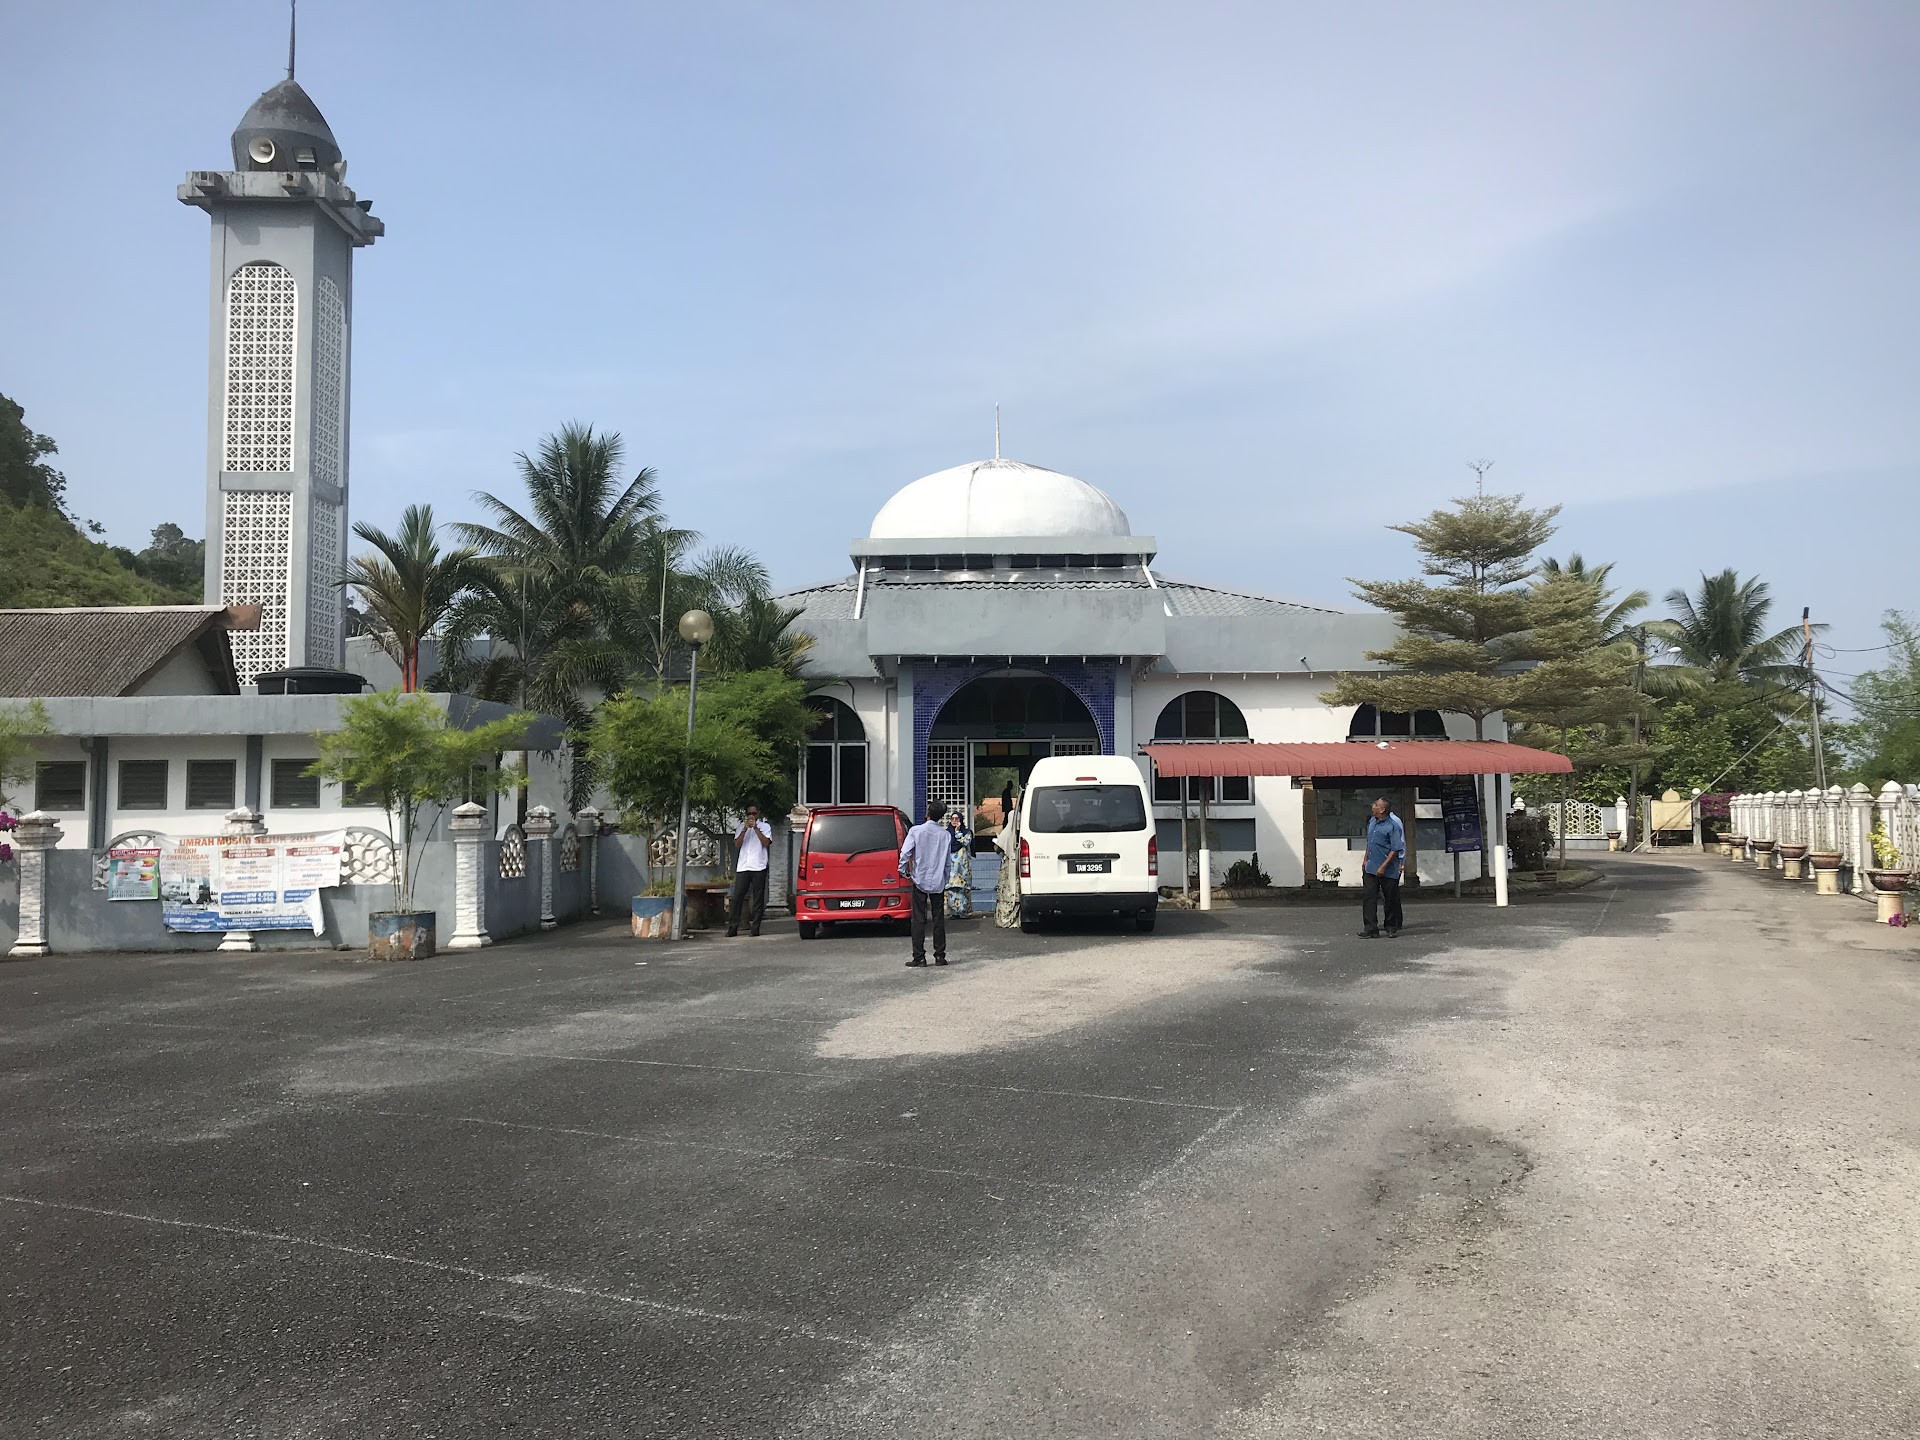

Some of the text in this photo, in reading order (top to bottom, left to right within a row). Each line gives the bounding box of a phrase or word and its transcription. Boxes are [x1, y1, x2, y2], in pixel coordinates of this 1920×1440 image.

[180, 837, 214, 846] UMRAH
[217, 836, 251, 845] MUSIM
[254, 835, 286, 844] SEJUK
[1086, 864, 1103, 872] 3295
